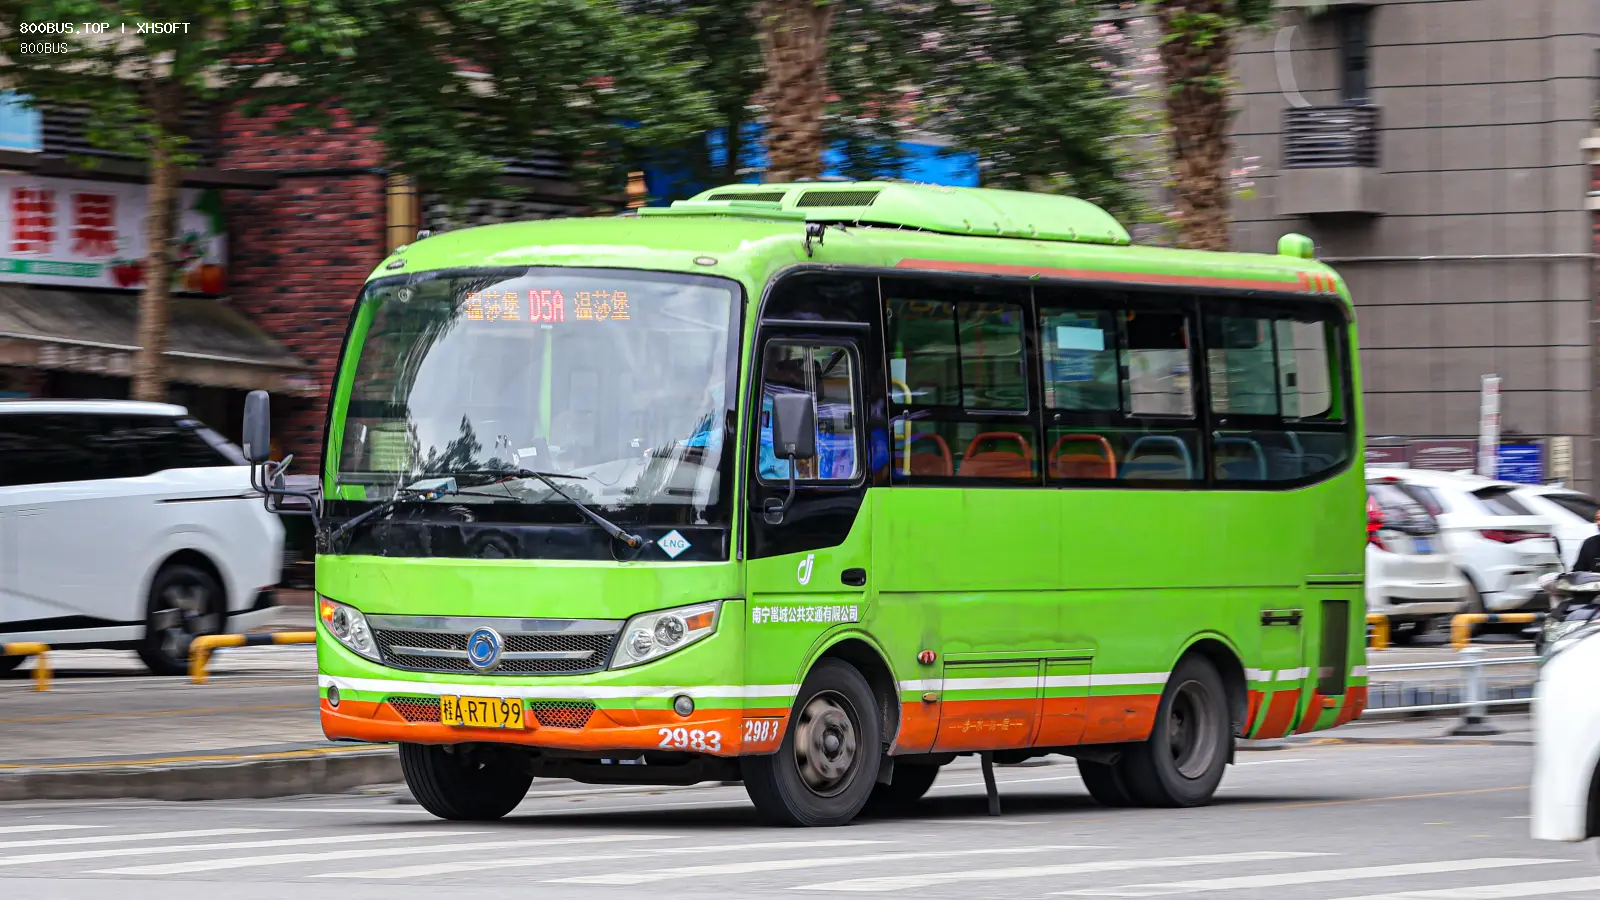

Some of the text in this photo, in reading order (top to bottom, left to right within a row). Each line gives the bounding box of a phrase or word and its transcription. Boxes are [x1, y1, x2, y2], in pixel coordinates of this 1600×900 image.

[465, 288, 630, 322] 温莎堡 D5A 温莎堡
[663, 539, 685, 548] LNG
[752, 605, 858, 624] 南宁邕城公共交通有限公司
[658, 728, 722, 753] 2983
[744, 720, 780, 742] 2983
